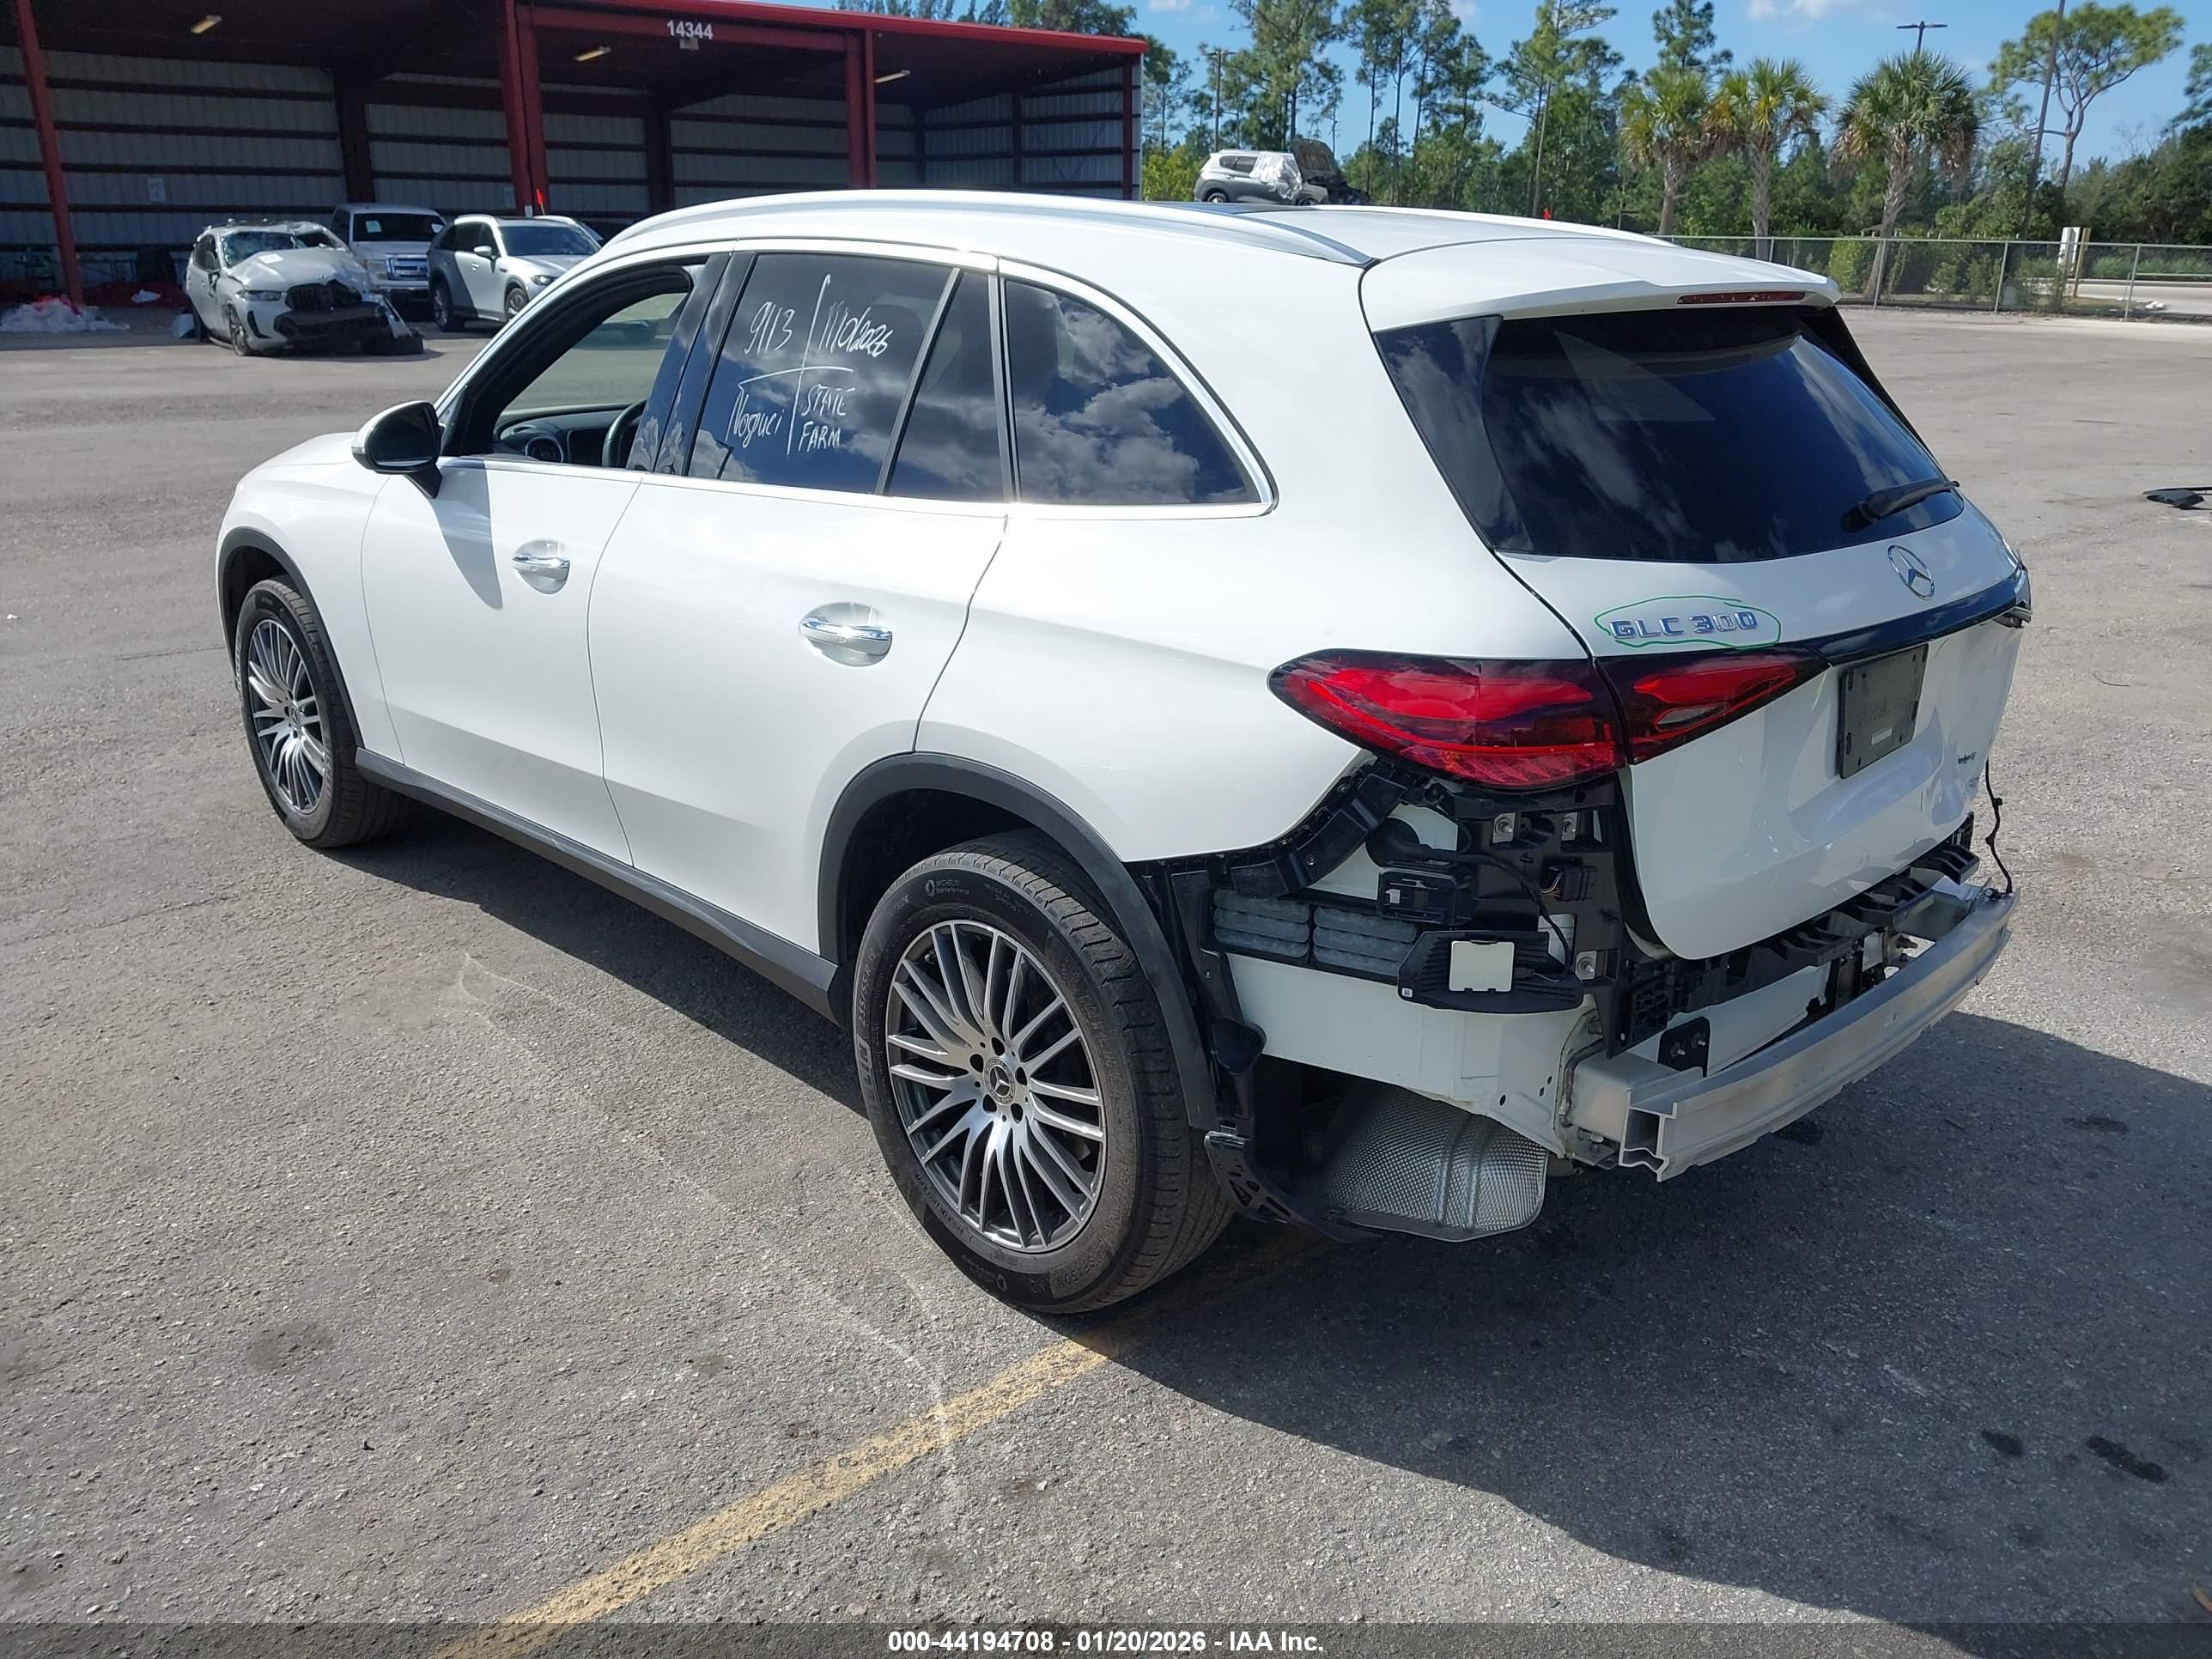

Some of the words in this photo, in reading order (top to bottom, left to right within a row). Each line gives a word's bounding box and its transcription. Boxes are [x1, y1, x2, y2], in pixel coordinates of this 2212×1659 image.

[666, 20, 714, 40] 14344
[798, 421, 841, 453] FARM
[1608, 617, 1684, 639] GLC
[1689, 611, 1759, 635] 300
